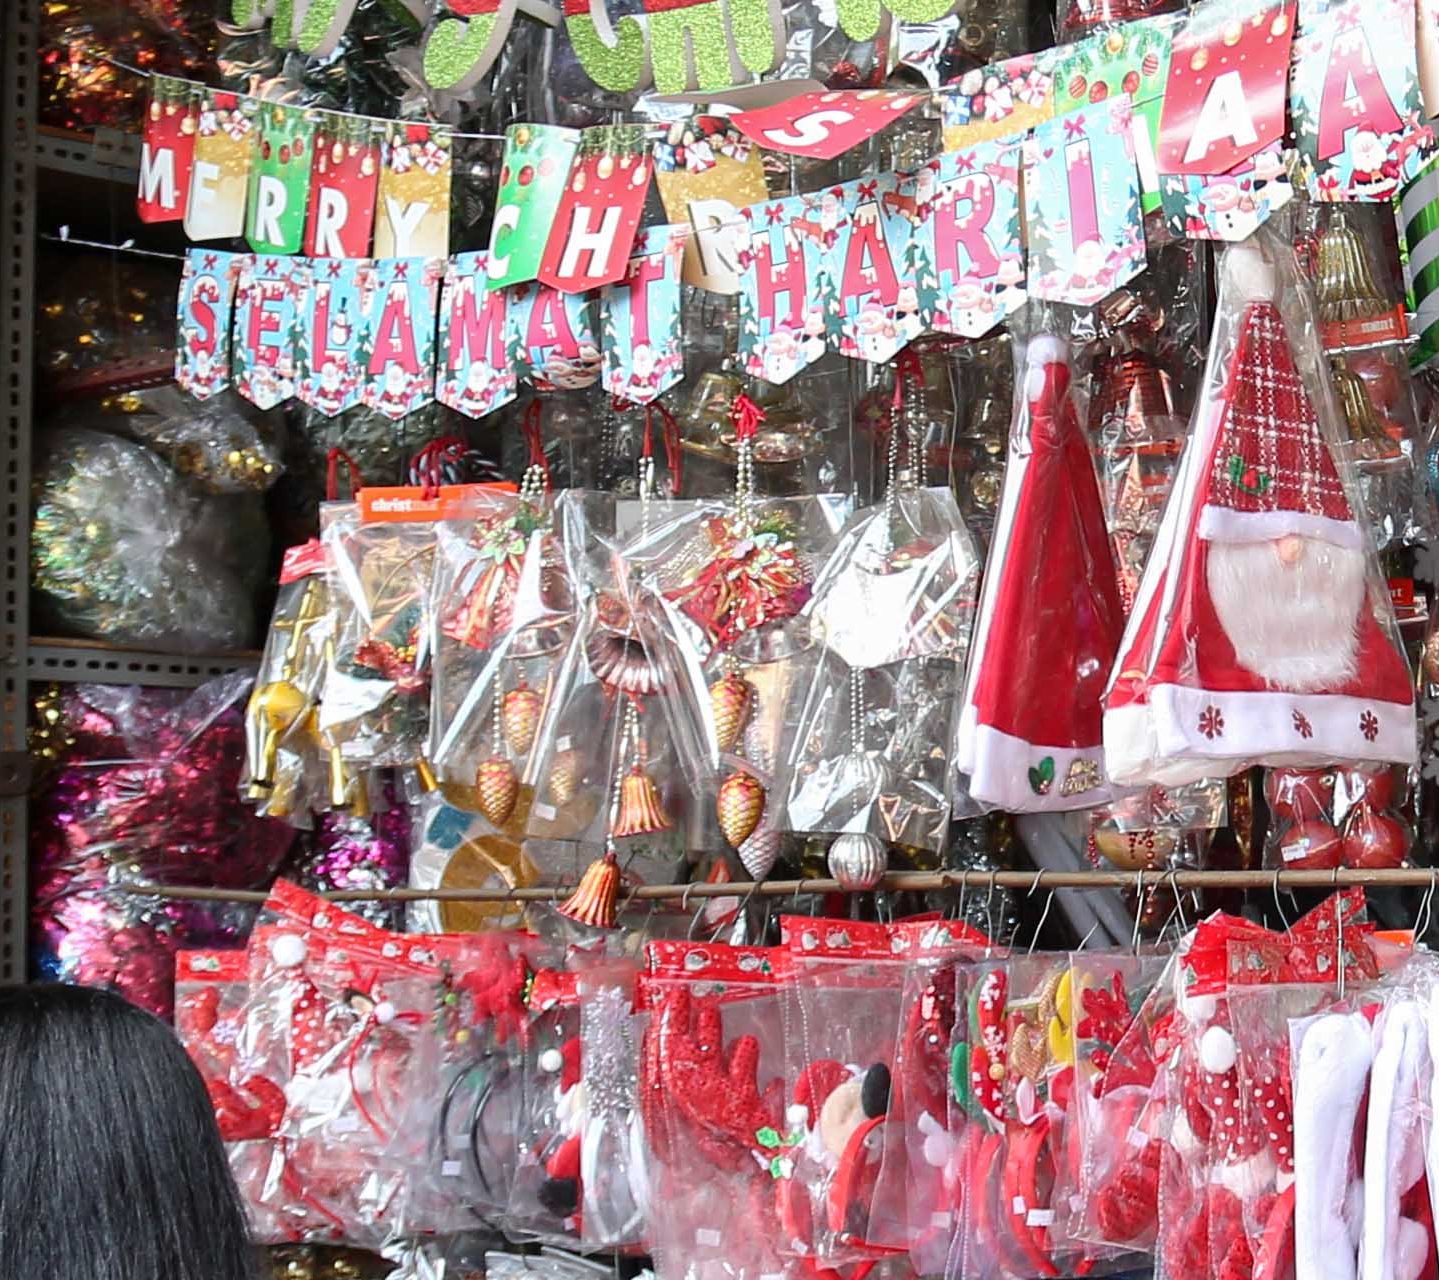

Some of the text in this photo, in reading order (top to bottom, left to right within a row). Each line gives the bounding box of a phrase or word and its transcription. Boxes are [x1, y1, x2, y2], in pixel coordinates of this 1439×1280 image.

[138, 141, 430, 257] MERRY
[190, 257, 668, 378] SELAMAT
[749, 137, 1101, 331] HARI
